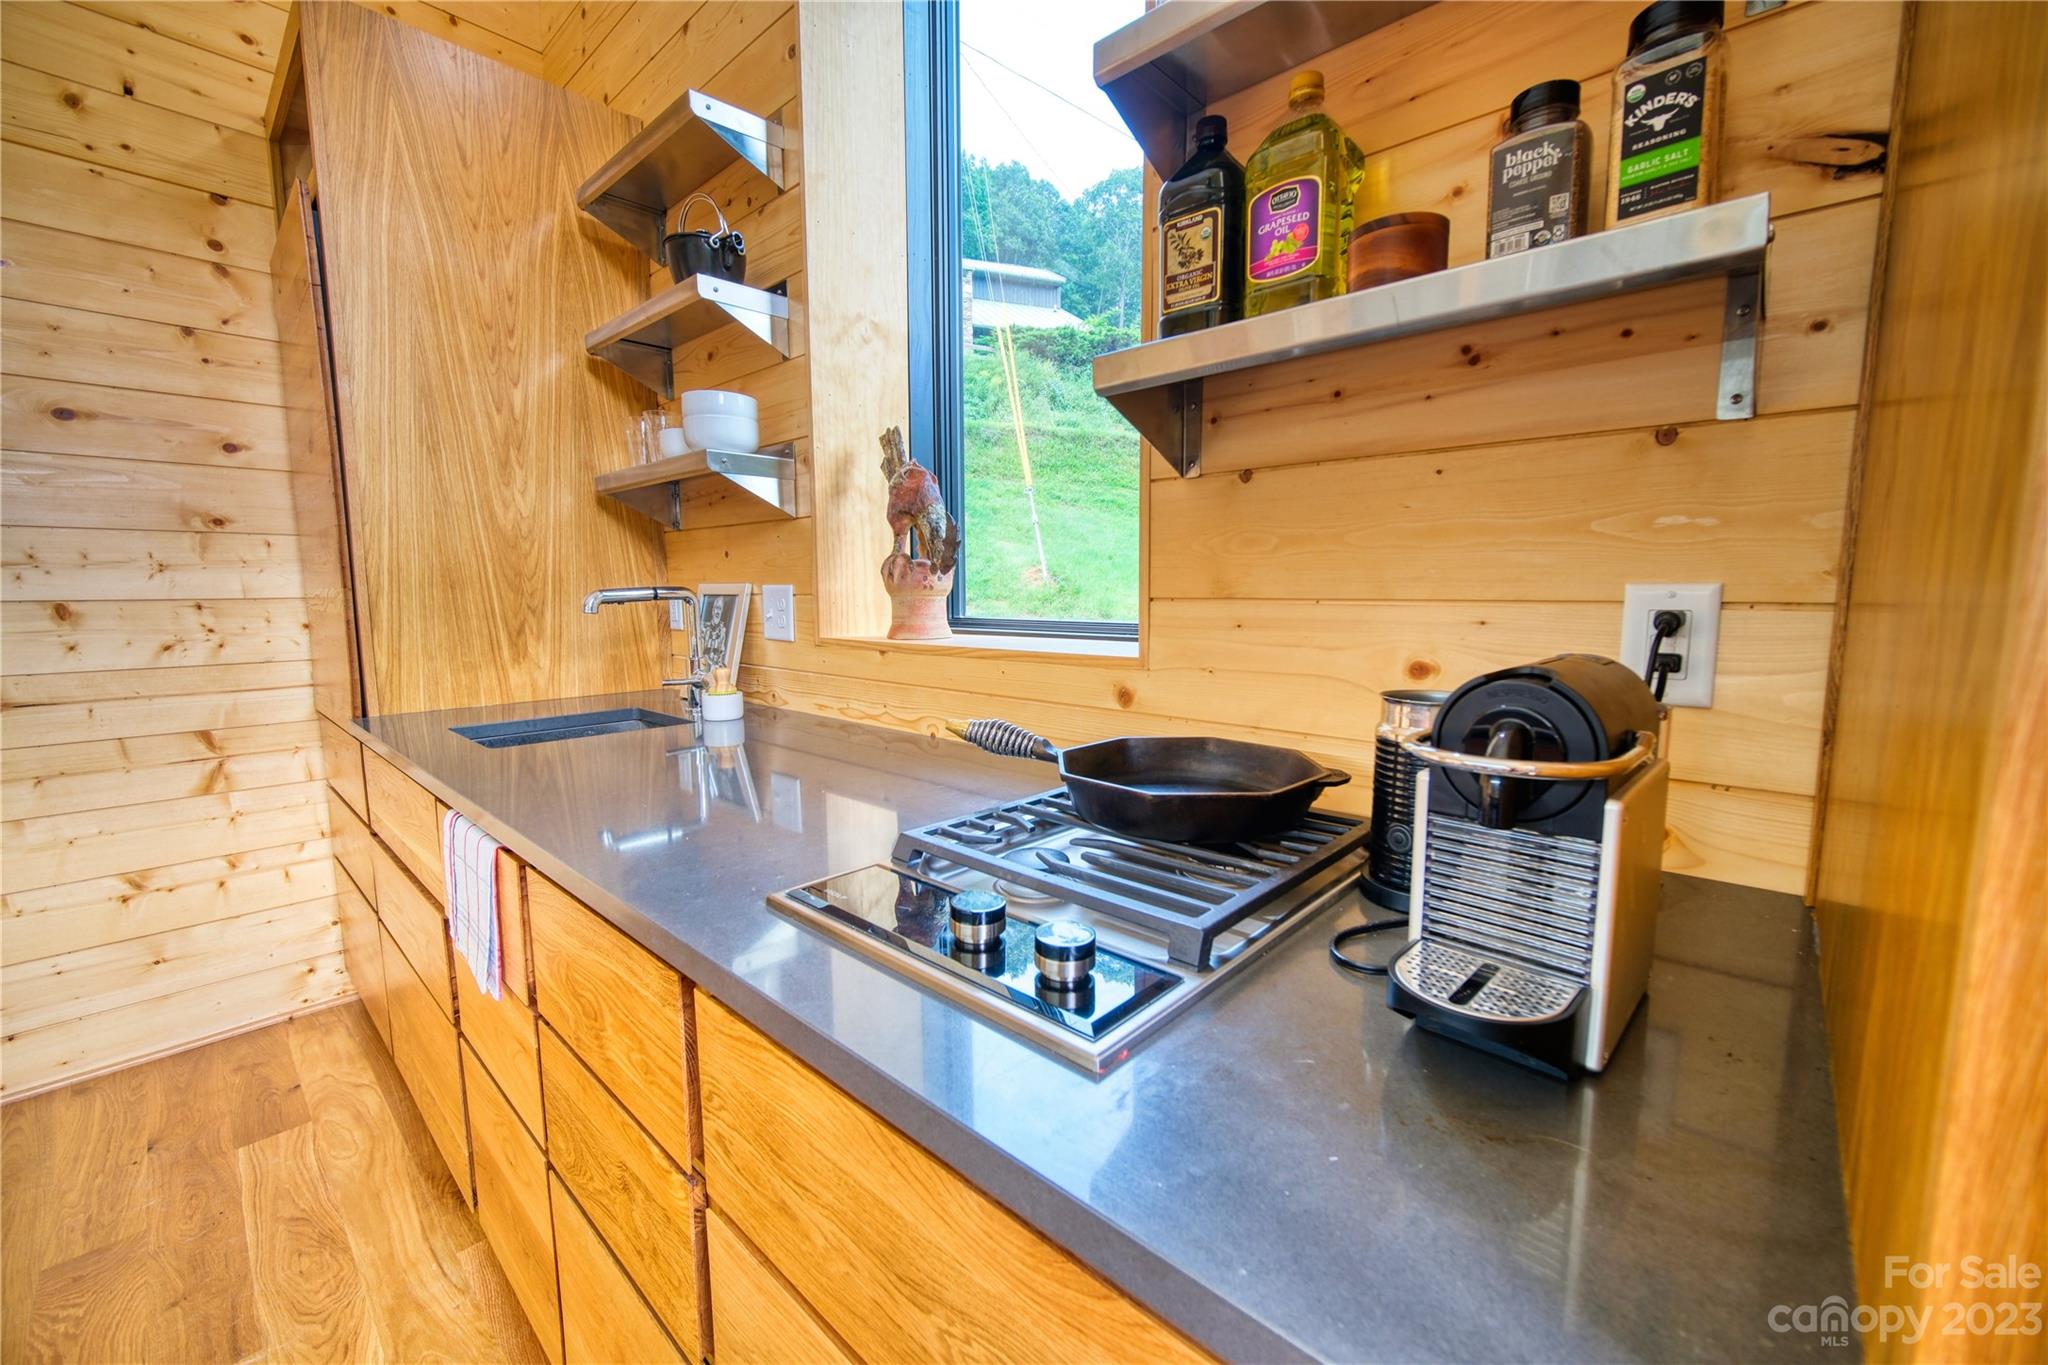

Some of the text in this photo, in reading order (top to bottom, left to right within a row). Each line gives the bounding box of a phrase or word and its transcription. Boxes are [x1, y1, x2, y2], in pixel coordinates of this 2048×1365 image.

[1624, 91, 1698, 127] KINDER'S
[1631, 128, 1687, 151] SEASONING
[1505, 141, 1560, 168] black
[1627, 157, 1661, 174] GARLIC
[1664, 148, 1689, 162] SALT
[1502, 152, 1562, 185] pepper
[1258, 211, 1310, 235] GRAPESEED
[1274, 225, 1291, 236] OIL
[1166, 272, 1213, 290] EXTRA VIRGIN
[1176, 269, 1203, 281] ORGANIC
